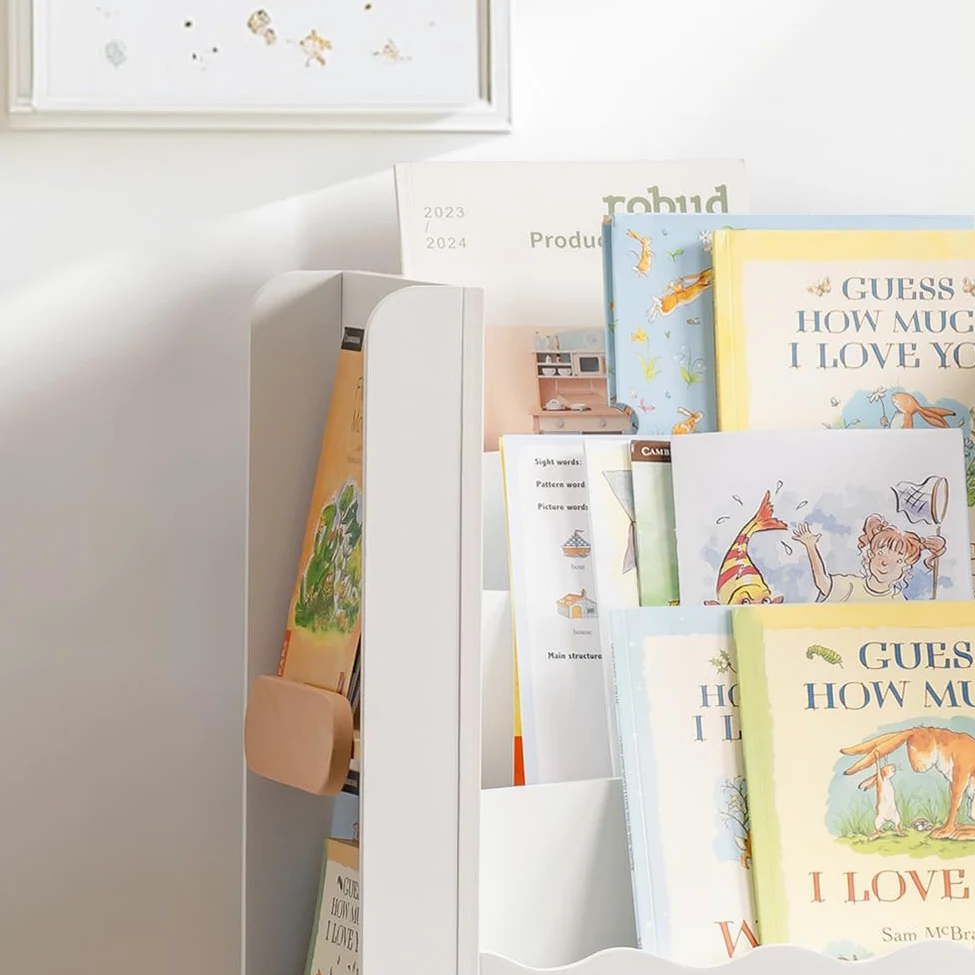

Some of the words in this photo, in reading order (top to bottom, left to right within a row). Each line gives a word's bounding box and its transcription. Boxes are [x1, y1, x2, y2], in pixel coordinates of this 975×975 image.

[602, 184, 729, 214] robud
[423, 206, 465, 219] 2023
[426, 237, 467, 250] 2024
[841, 276, 955, 301] GUESS
[795, 309, 881, 334] HOW
[787, 342, 802, 369] I
[815, 341, 921, 370] LOVE
[534, 457, 555, 467] Sight
[535, 480, 565, 489] Pattern
[537, 503, 565, 512] Picture
[547, 652, 567, 660] Main
[803, 680, 911, 711] HOW
[693, 715, 706, 742] I
[809, 871, 826, 903] I
[844, 868, 970, 905] LOVE
[882, 926, 917, 942] Sam
